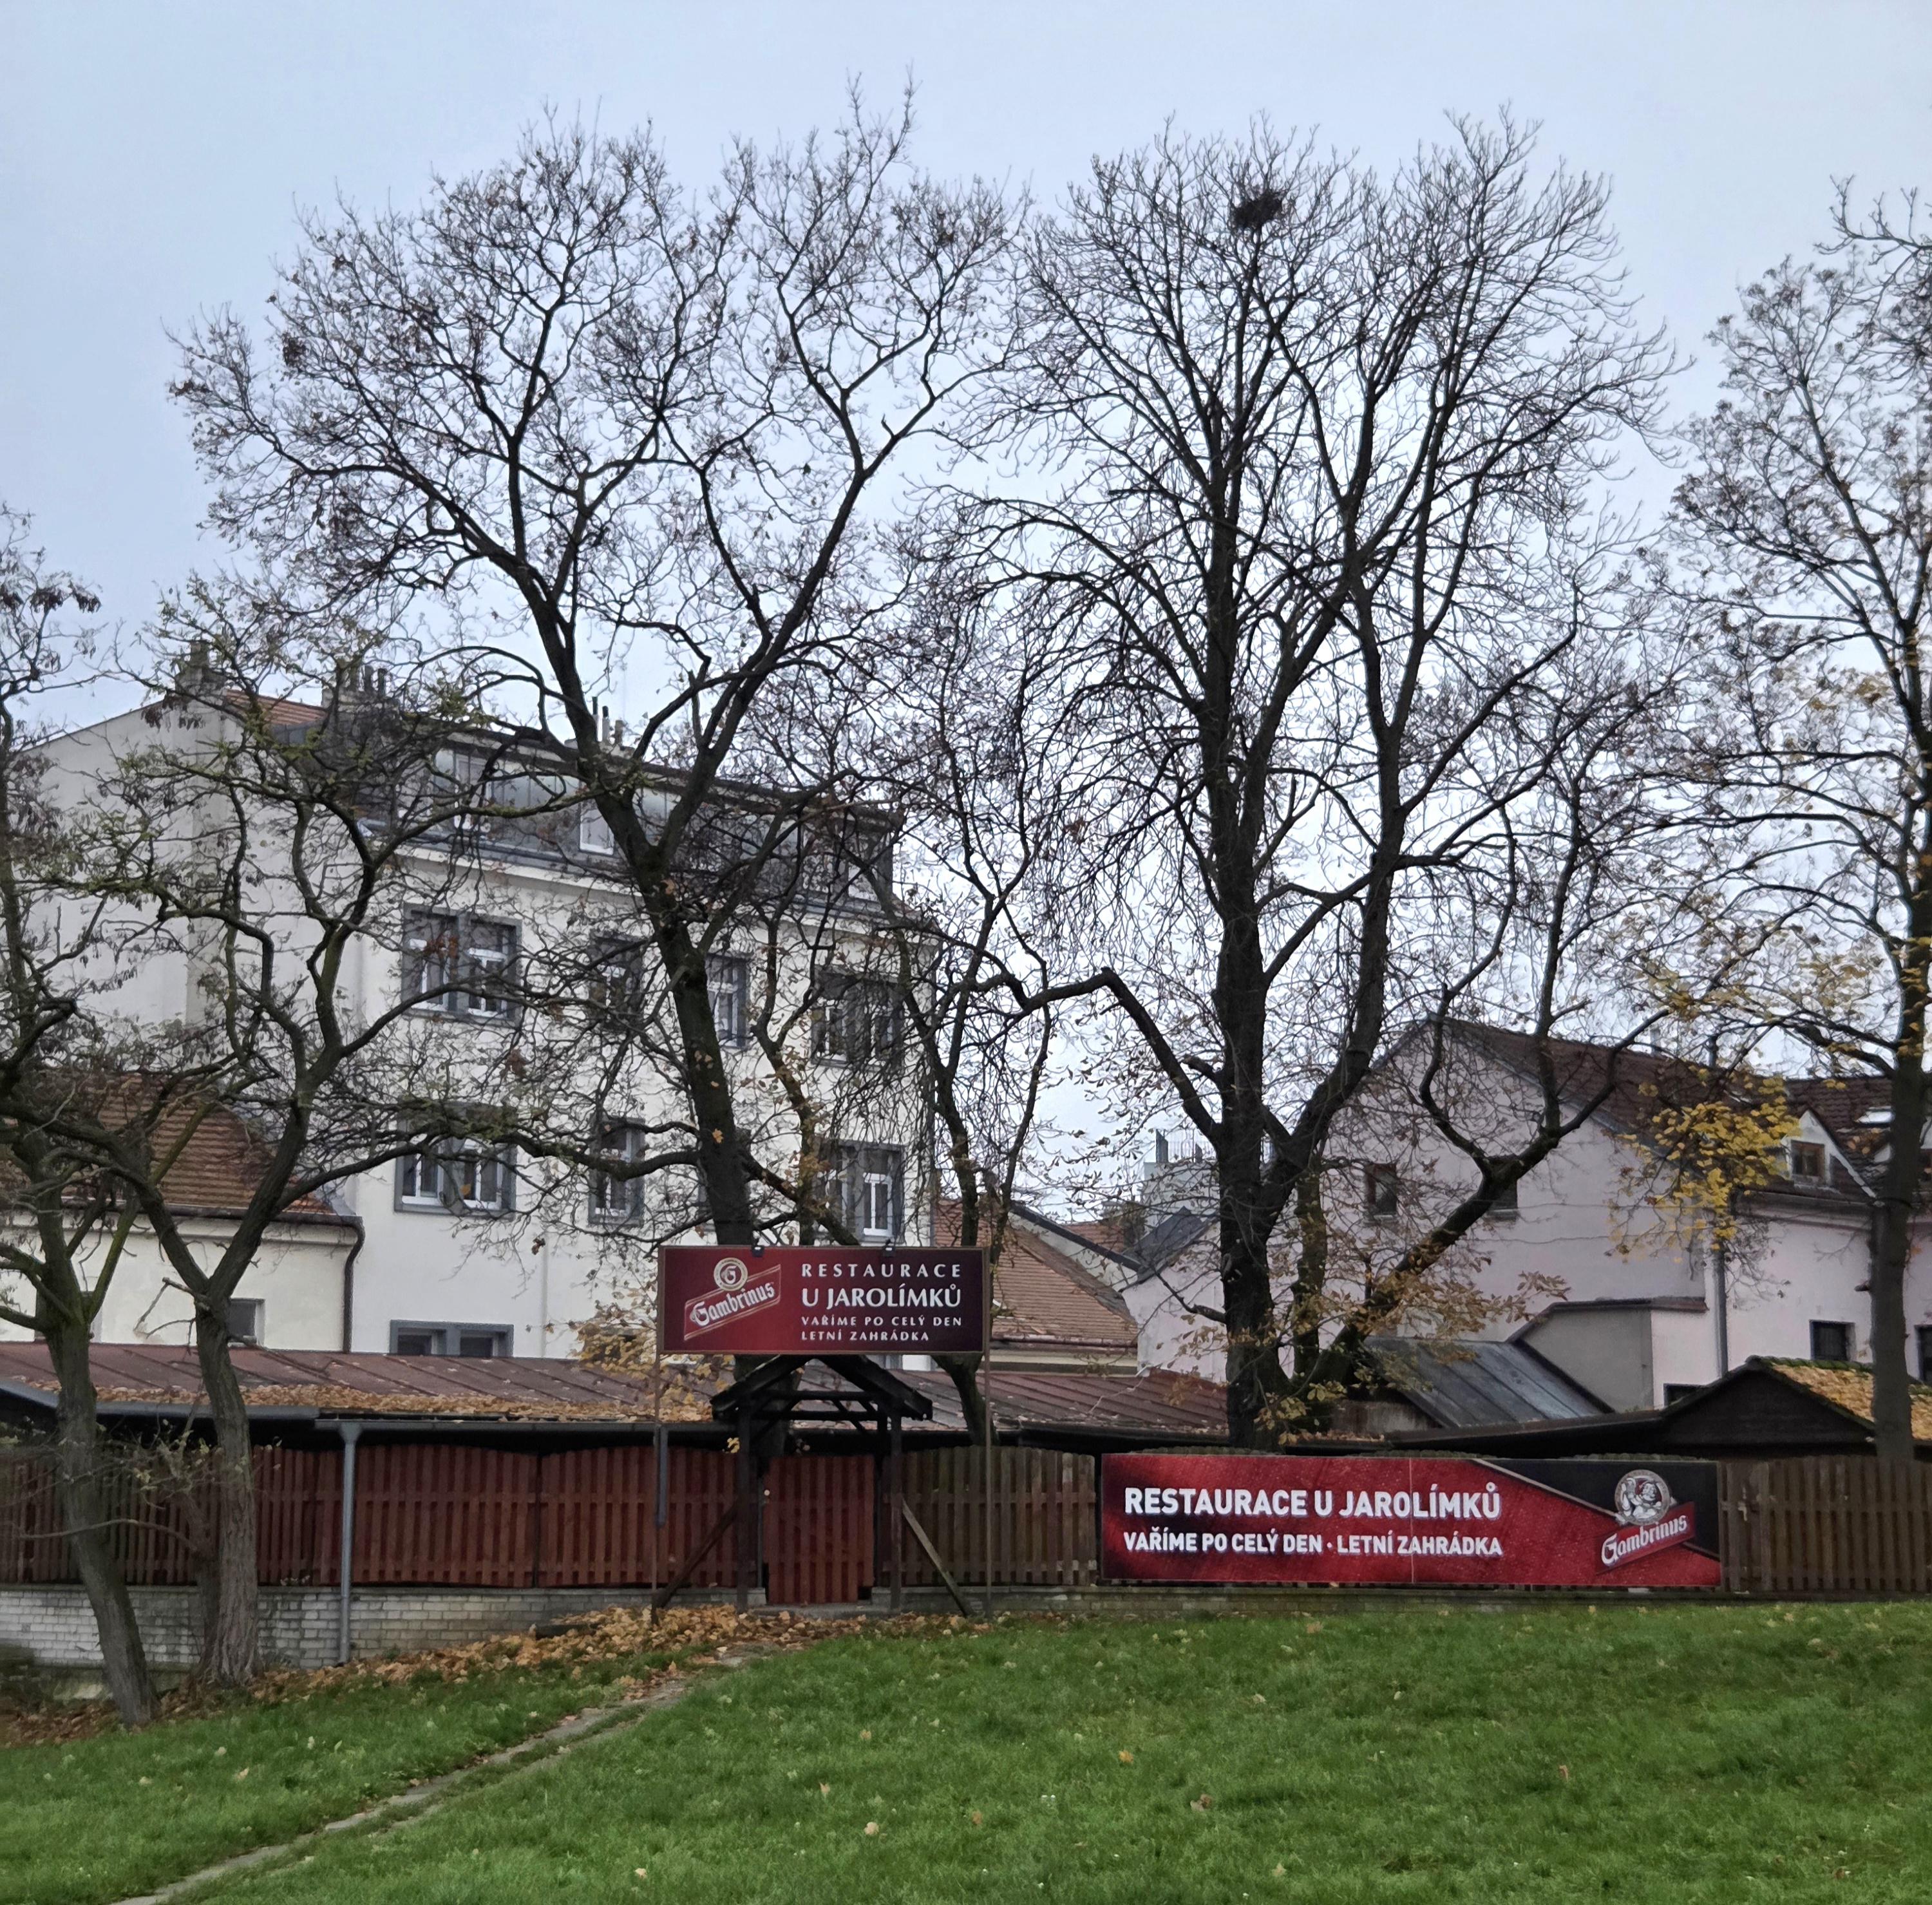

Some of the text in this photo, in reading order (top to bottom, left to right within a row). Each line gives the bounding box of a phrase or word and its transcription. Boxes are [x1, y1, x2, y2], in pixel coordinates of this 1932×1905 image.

[801, 1263, 961, 1278] RESTAURACE
[690, 1282, 775, 1327] Gambrinus
[802, 1283, 961, 1310] U JAROLÍMKŮ
[801, 1313, 962, 1327] VAŘÍME PO CELÝ DEN
[801, 1329, 929, 1341] LETNÍ ZAHRÁDKA
[1124, 1481, 1501, 1519] RESTAURACE U JAROLÍMKŮ
[1123, 1526, 1504, 1556] VAŘÍME PO CELÝ DEN LETNÍ ZAHRÁDKA
[1601, 1514, 1688, 1565] Gambrinus
